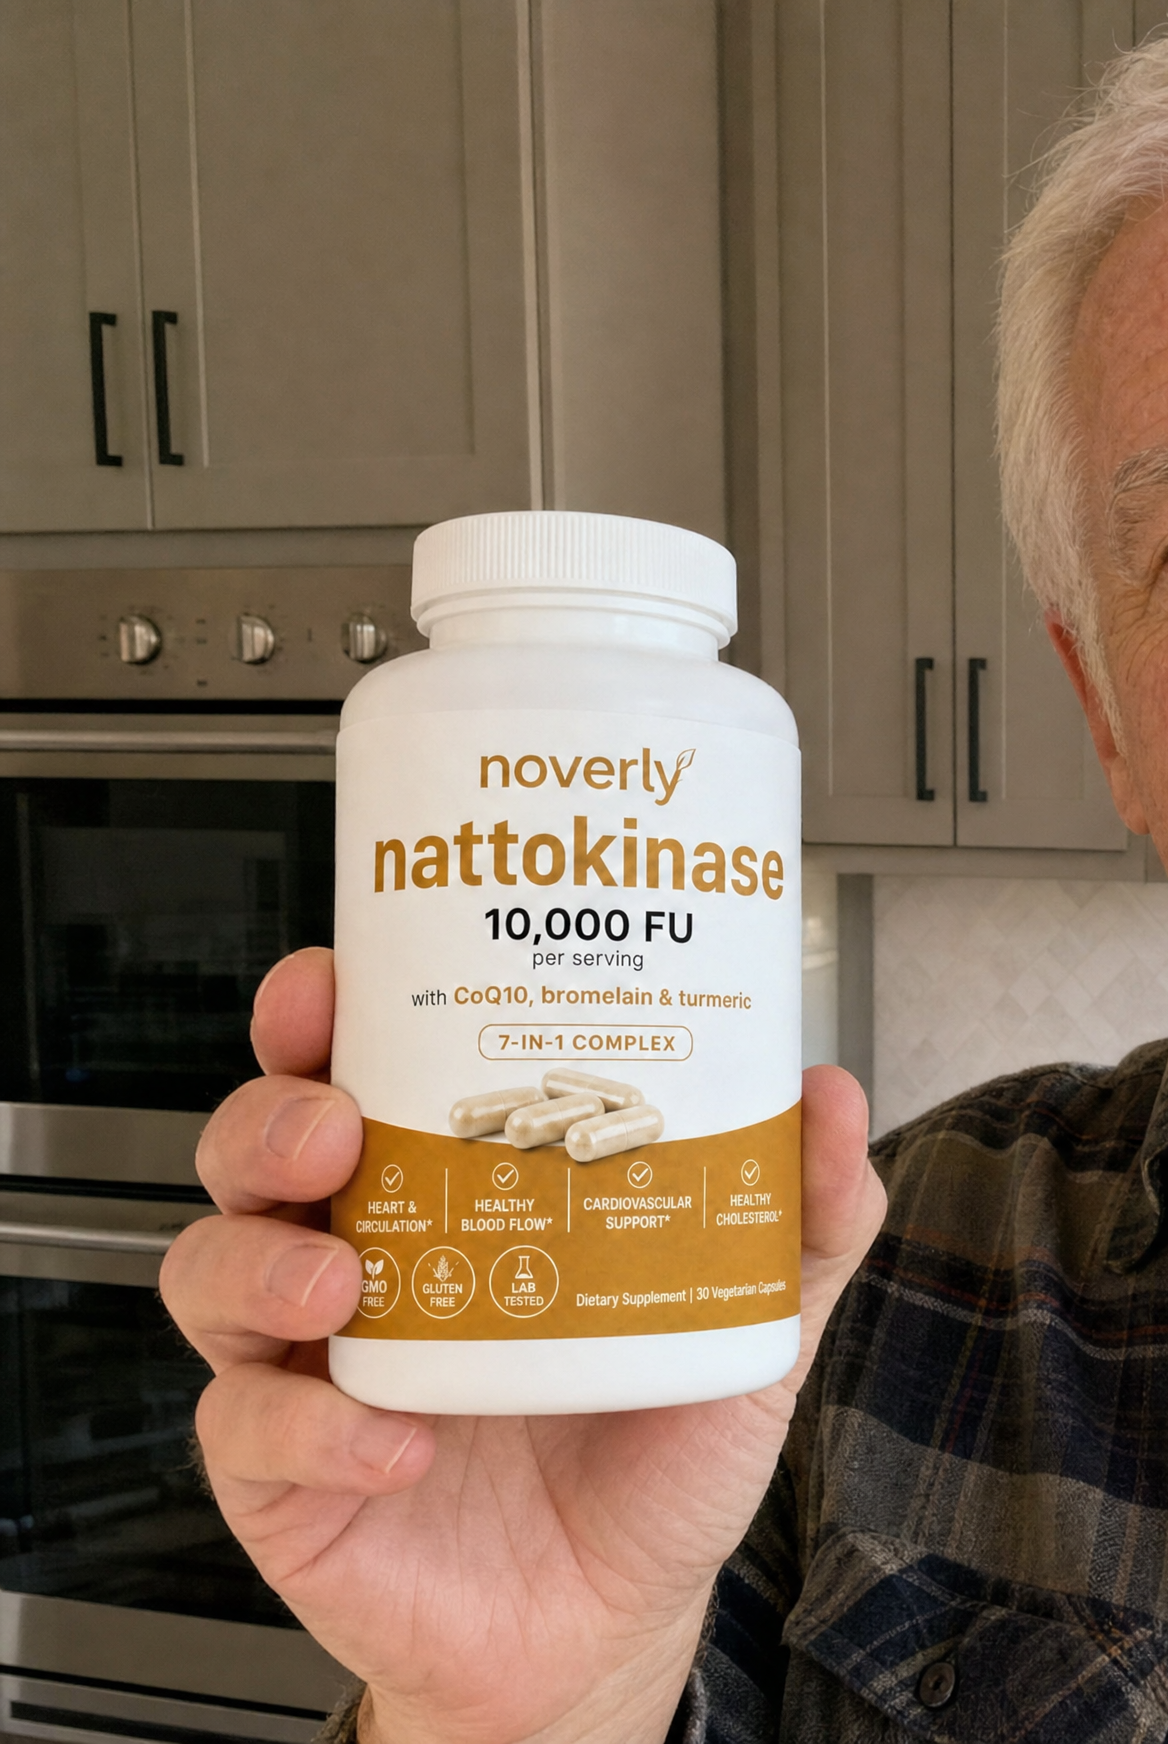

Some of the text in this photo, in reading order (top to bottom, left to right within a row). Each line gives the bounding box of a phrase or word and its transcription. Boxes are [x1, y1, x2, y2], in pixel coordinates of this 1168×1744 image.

[480, 747, 696, 806] noverly
[374, 816, 784, 900] nattokinase
[484, 908, 693, 945] 10,000 FU
[532, 950, 644, 972] per serving
[411, 986, 752, 1010] with CoQ10, bromelain & turmeric
[498, 1034, 676, 1052] 7-IN-1 COMPLEX
[475, 1199, 535, 1212] HEALTHY
[583, 1196, 692, 1211] CARDIOVASCULAR
[730, 1193, 771, 1207] HEALTHY
[368, 1201, 417, 1214] HEART &
[461, 1218, 505, 1231] BLOOD
[361, 1280, 387, 1293] GMO
[422, 1283, 463, 1294] GLUTEN
[511, 1282, 536, 1293] LAB
[576, 1293, 619, 1308] Dietary
[622, 1290, 686, 1308] Supplement
[696, 1287, 709, 1300] 30
[711, 1283, 756, 1301] Vegetarian
[758, 1279, 786, 1296] Capsules
[362, 1296, 385, 1307] FREE
[430, 1297, 455, 1307] FREE
[504, 1296, 544, 1306] TESTED
